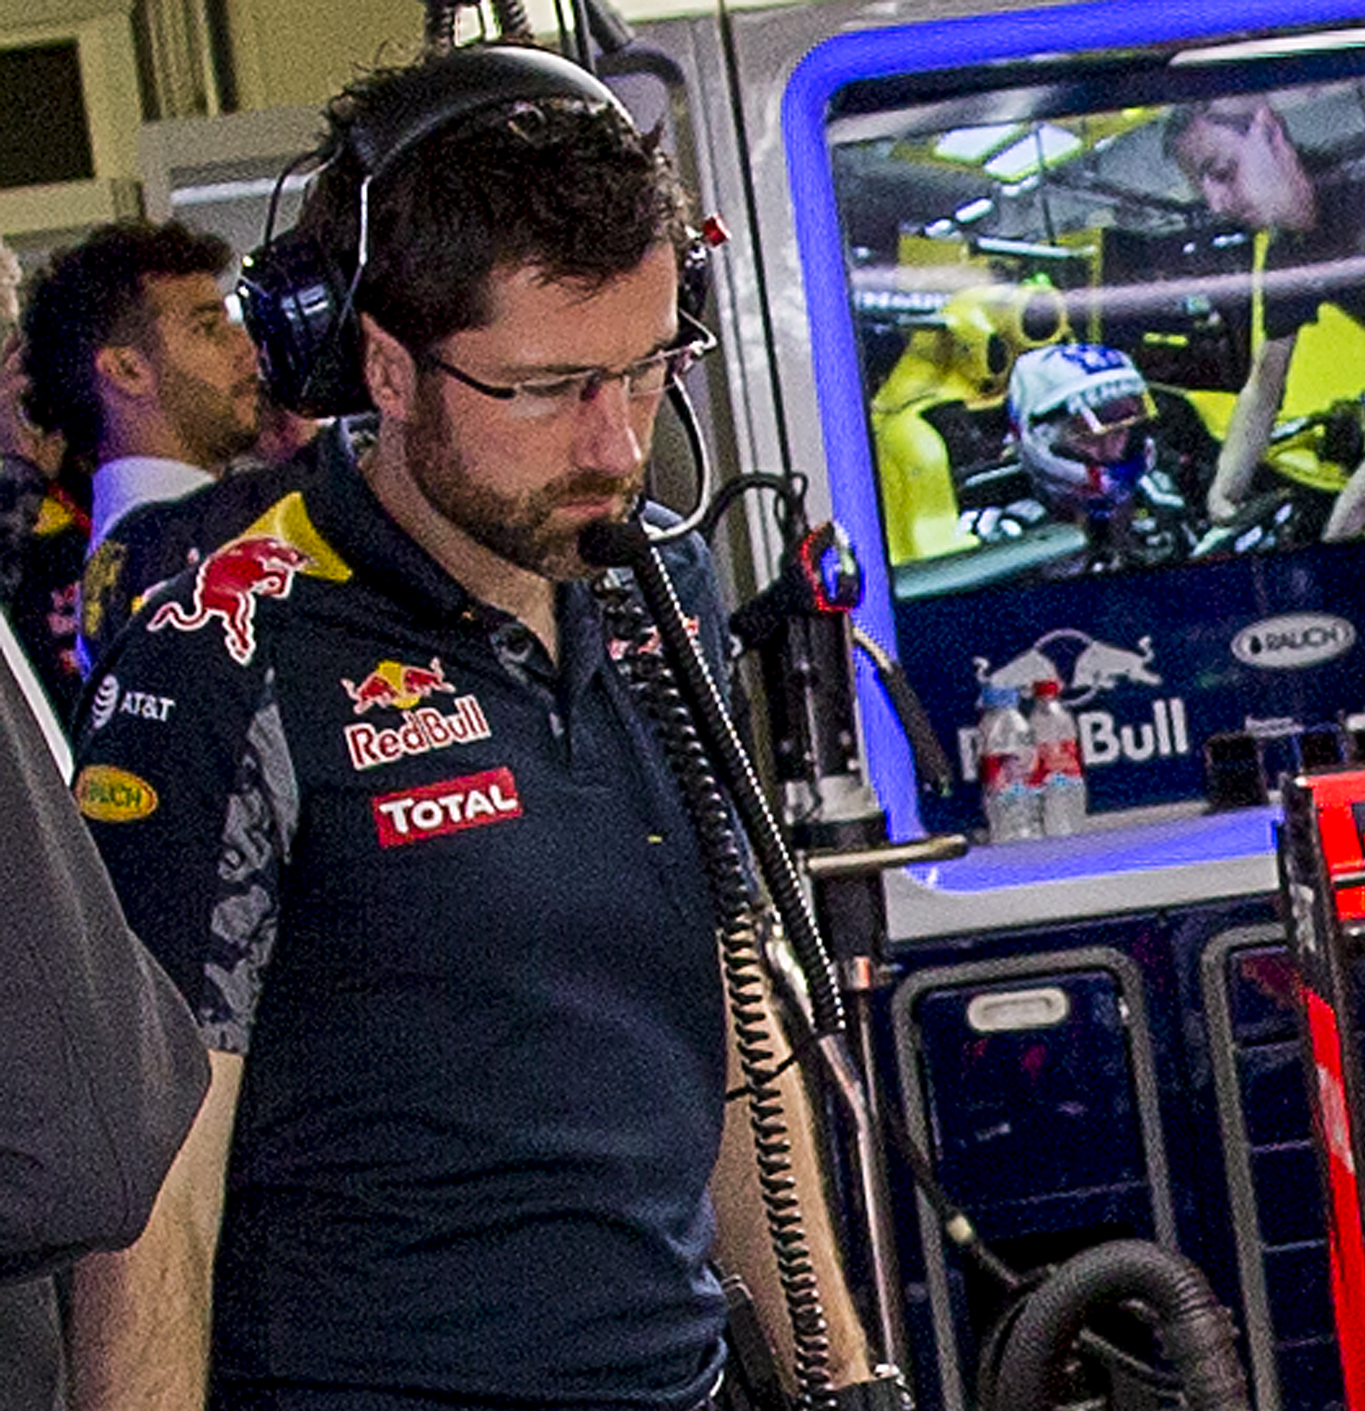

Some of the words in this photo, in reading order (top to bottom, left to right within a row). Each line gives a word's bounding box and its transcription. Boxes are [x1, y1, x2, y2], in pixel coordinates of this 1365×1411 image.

[119, 690, 177, 723] AT&T
[344, 710, 430, 771] Red
[416, 694, 493, 749] Bull
[1077, 697, 1189, 767] Bull
[378, 784, 519, 835] TOTAL
